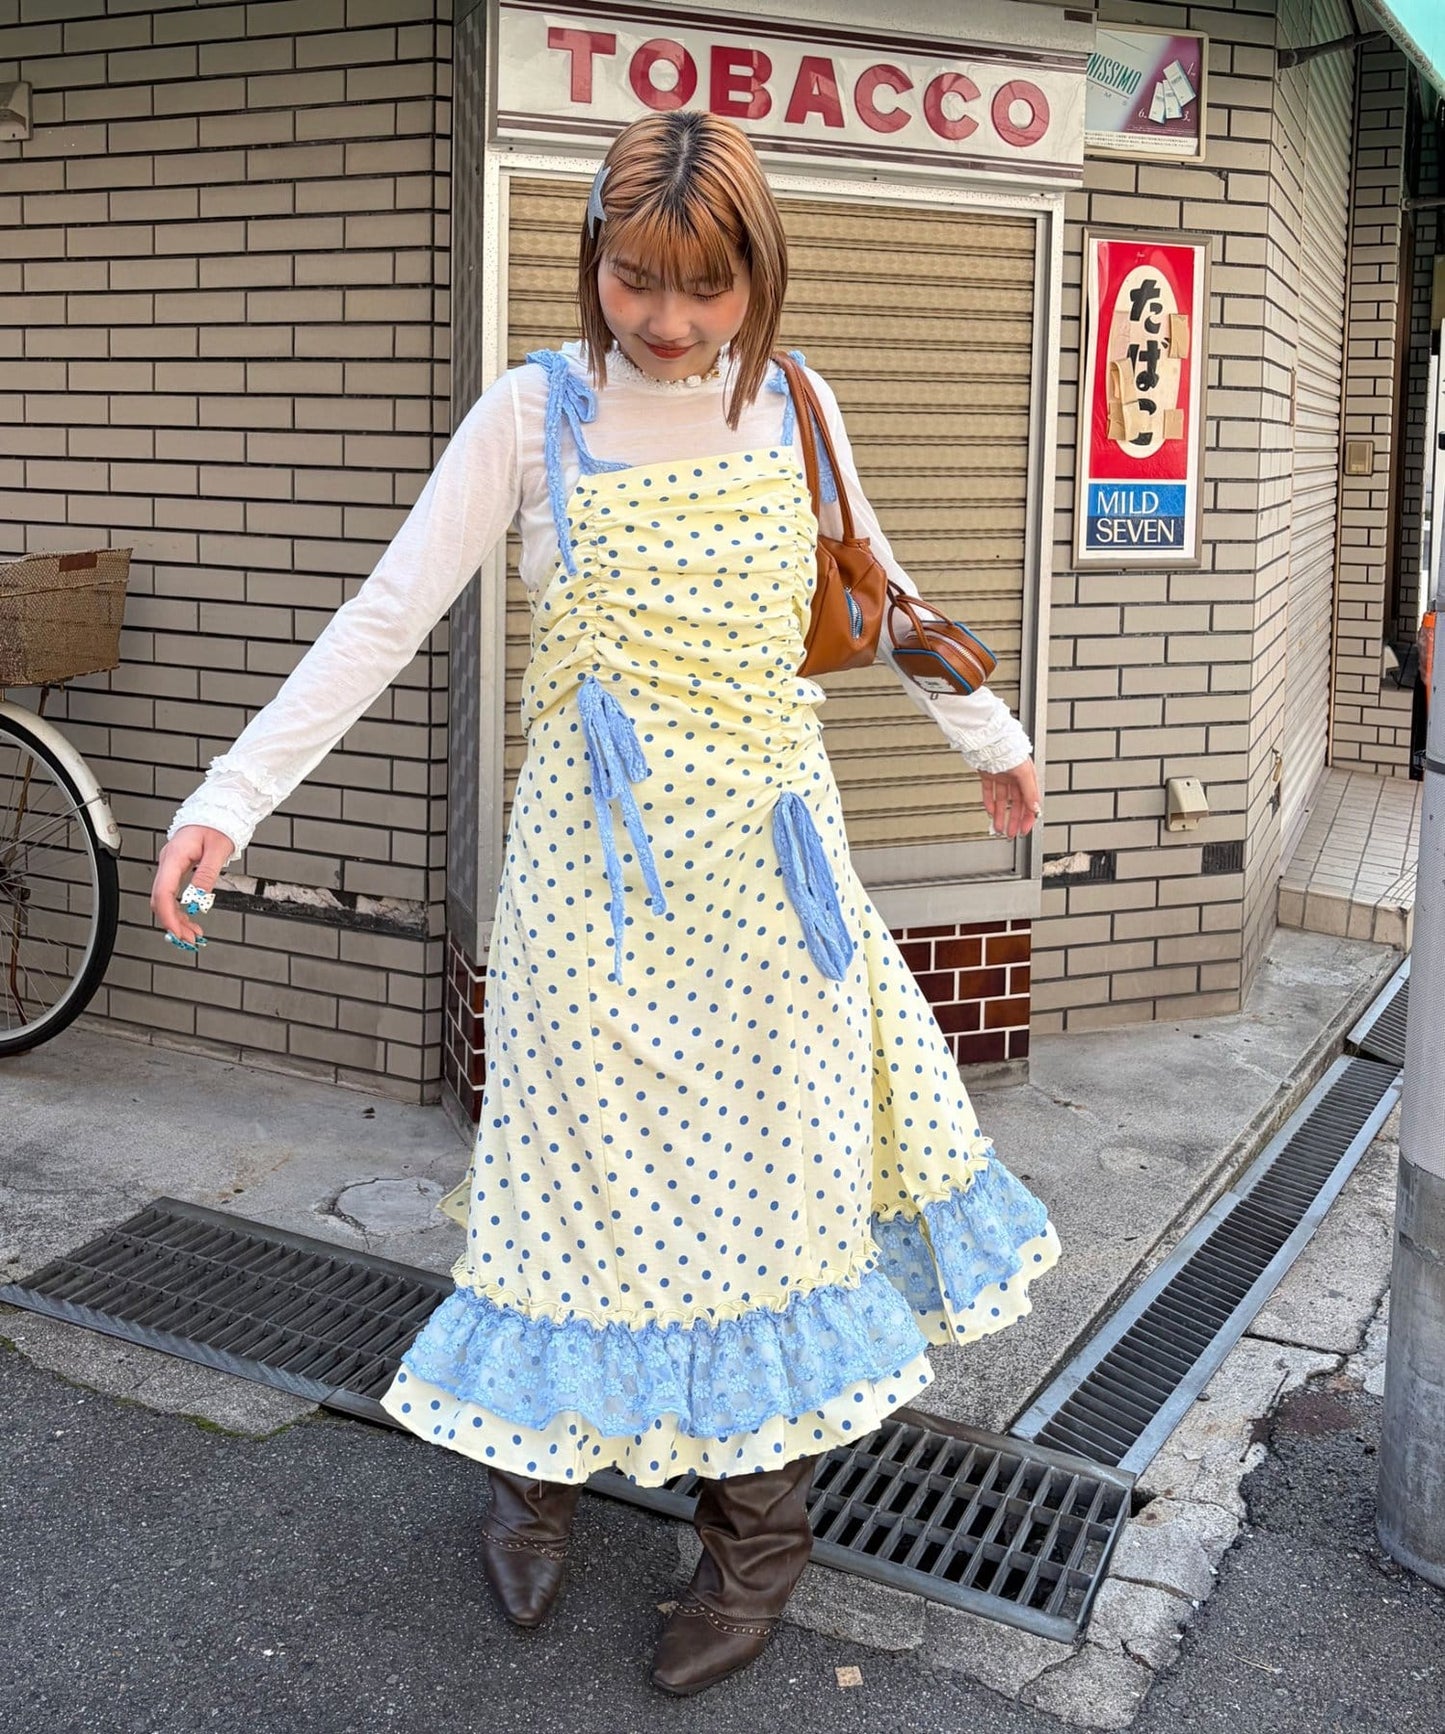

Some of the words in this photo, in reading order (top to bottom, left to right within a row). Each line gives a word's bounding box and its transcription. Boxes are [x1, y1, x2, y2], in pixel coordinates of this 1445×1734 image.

[547, 26, 1051, 148] TOBACCO
[1086, 52, 1142, 95] NISSIMO
[1097, 490, 1160, 515] MILD
[1095, 517, 1175, 543] SEVEN
